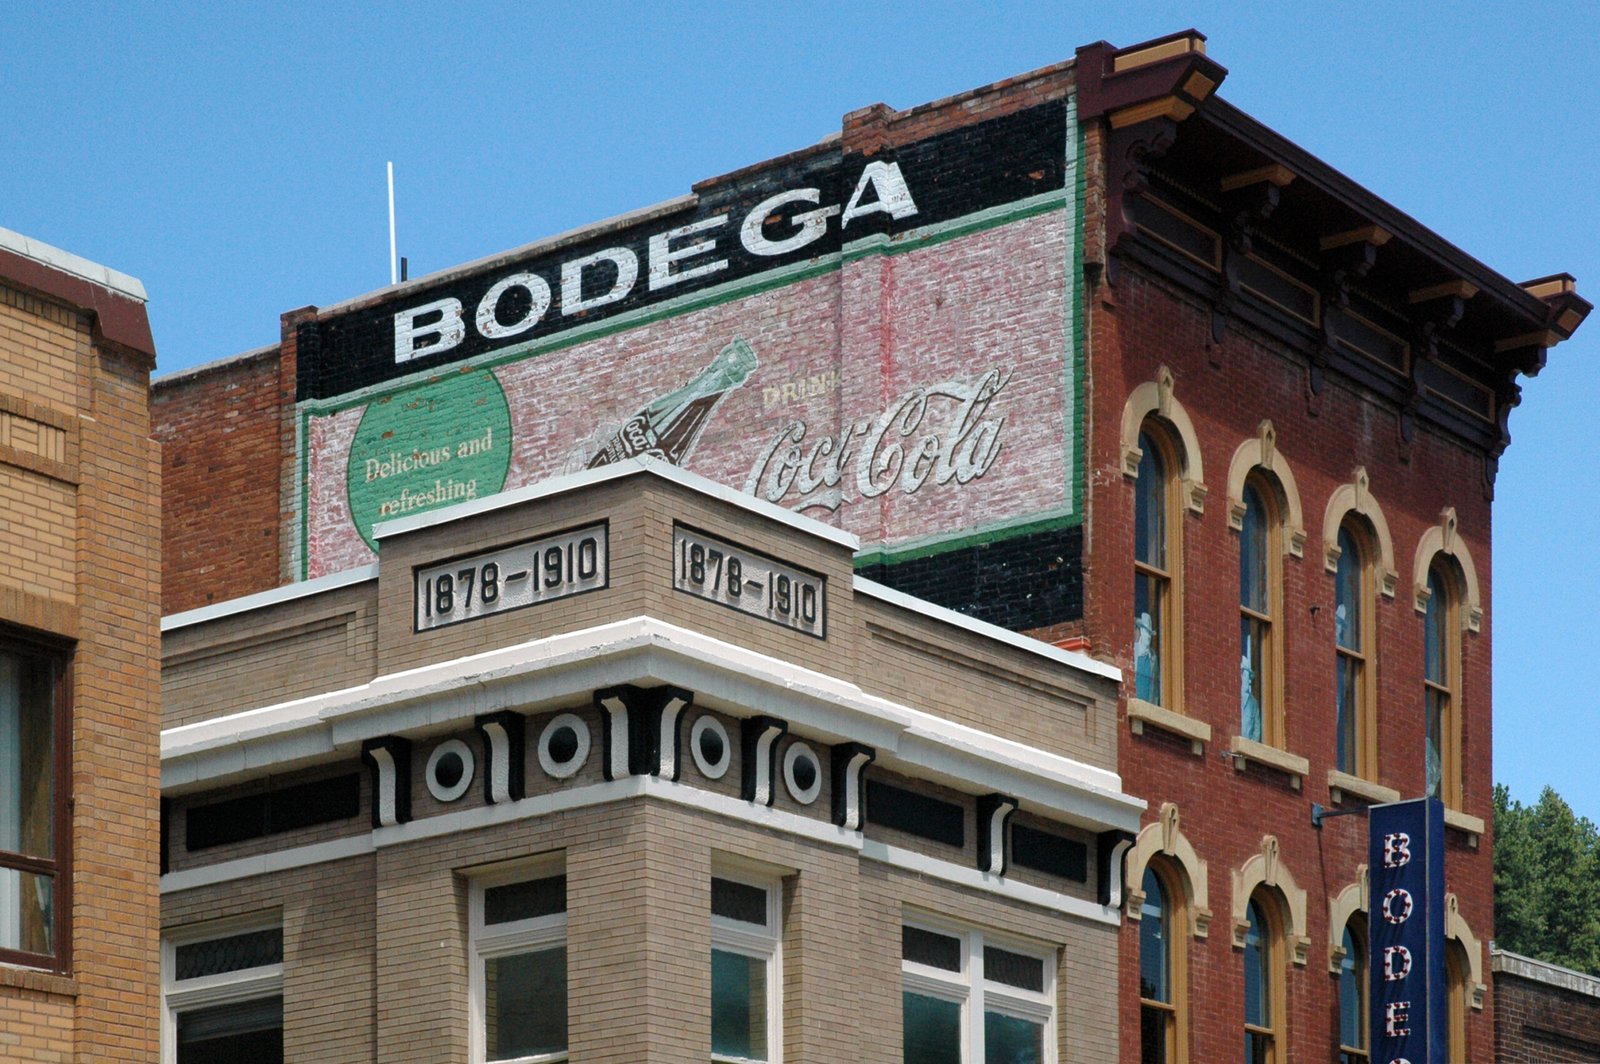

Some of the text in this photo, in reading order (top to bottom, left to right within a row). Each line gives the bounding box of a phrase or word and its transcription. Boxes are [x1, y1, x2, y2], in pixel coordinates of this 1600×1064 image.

[394, 160, 919, 364] BODEGA
[762, 370, 842, 408] DRINK
[365, 427, 493, 483] Delicious and
[742, 367, 1014, 513] Coca-Cola
[378, 479, 477, 517] refreshing
[1382, 832, 1414, 1064] BODE
